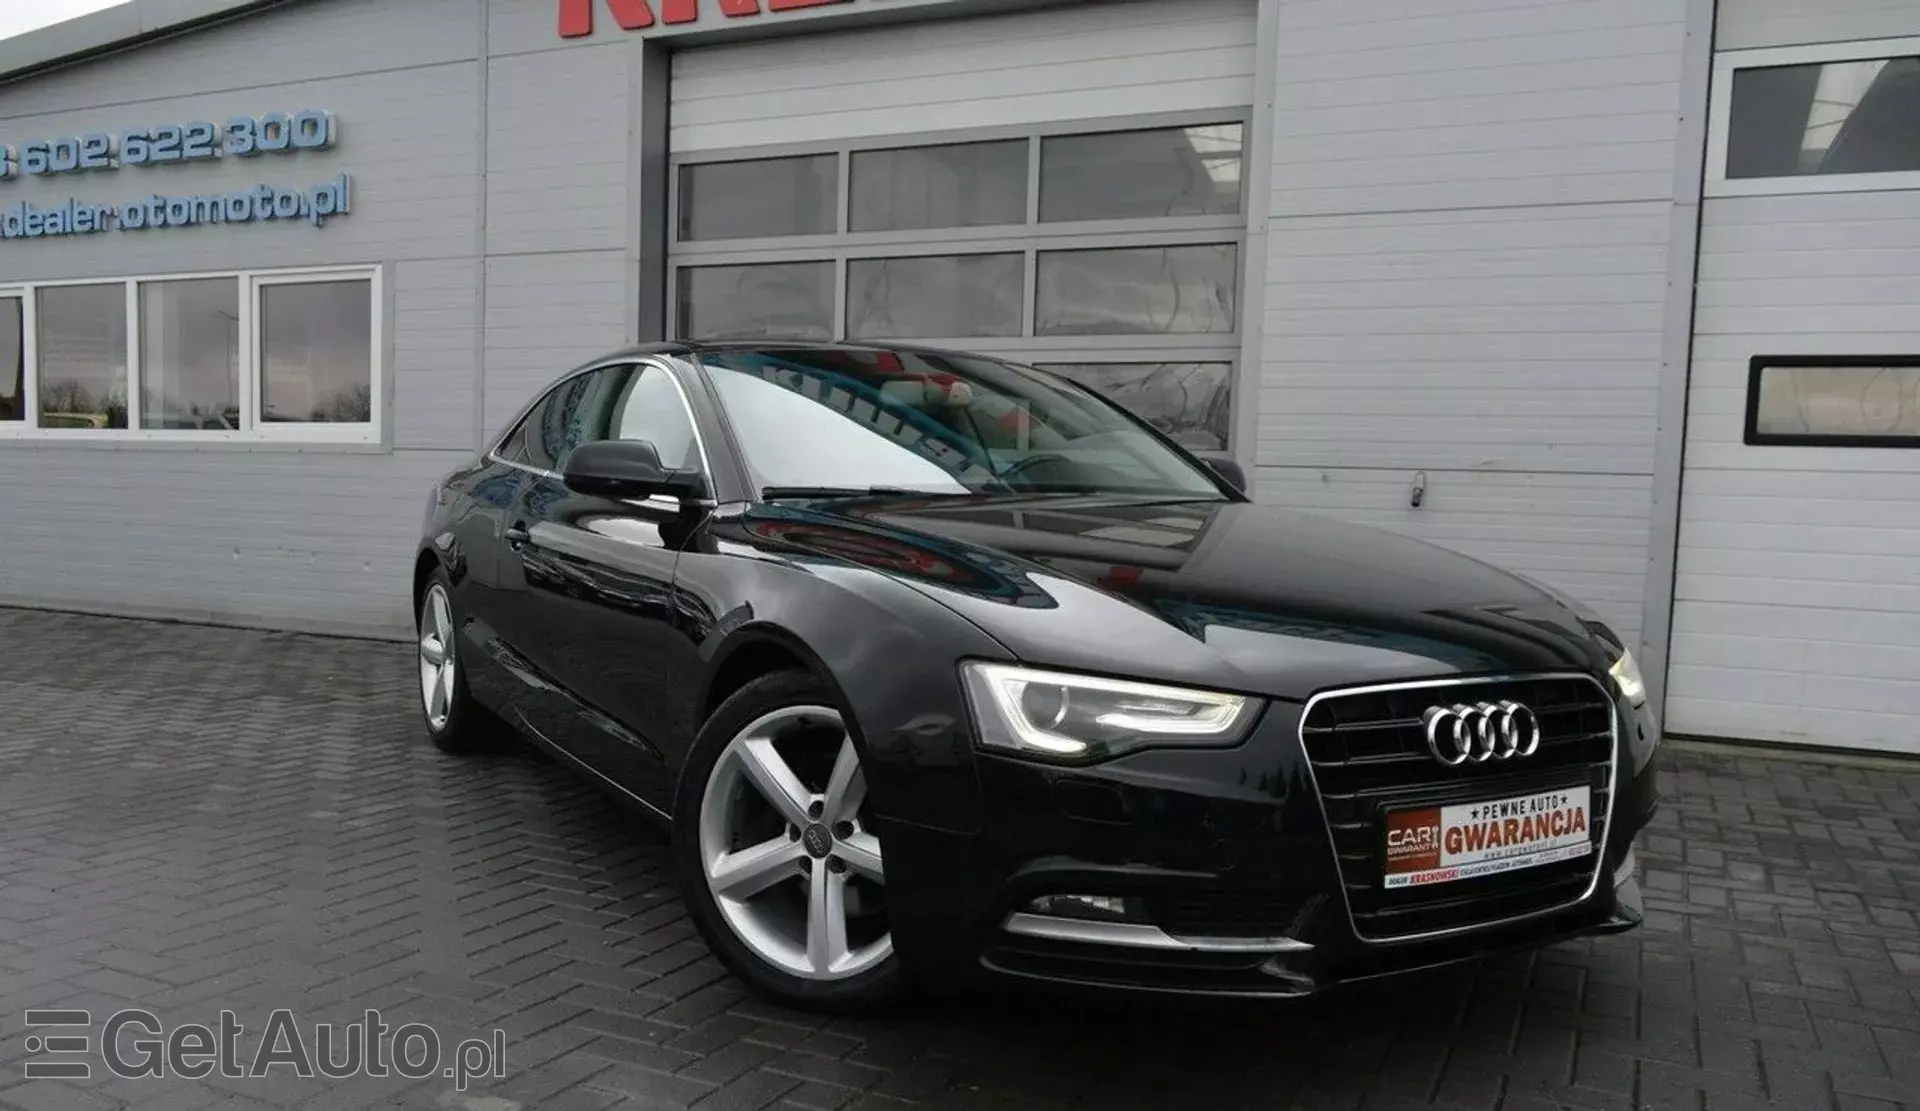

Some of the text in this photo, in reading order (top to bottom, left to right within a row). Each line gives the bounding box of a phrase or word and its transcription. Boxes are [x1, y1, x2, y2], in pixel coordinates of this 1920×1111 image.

[0, 171, 349, 238] dealer.otomoto.pl
[1483, 795, 1558, 820] PEWNE AUTO
[1387, 826, 1431, 846] CAR
[1445, 807, 1586, 855] GWARANCJA
